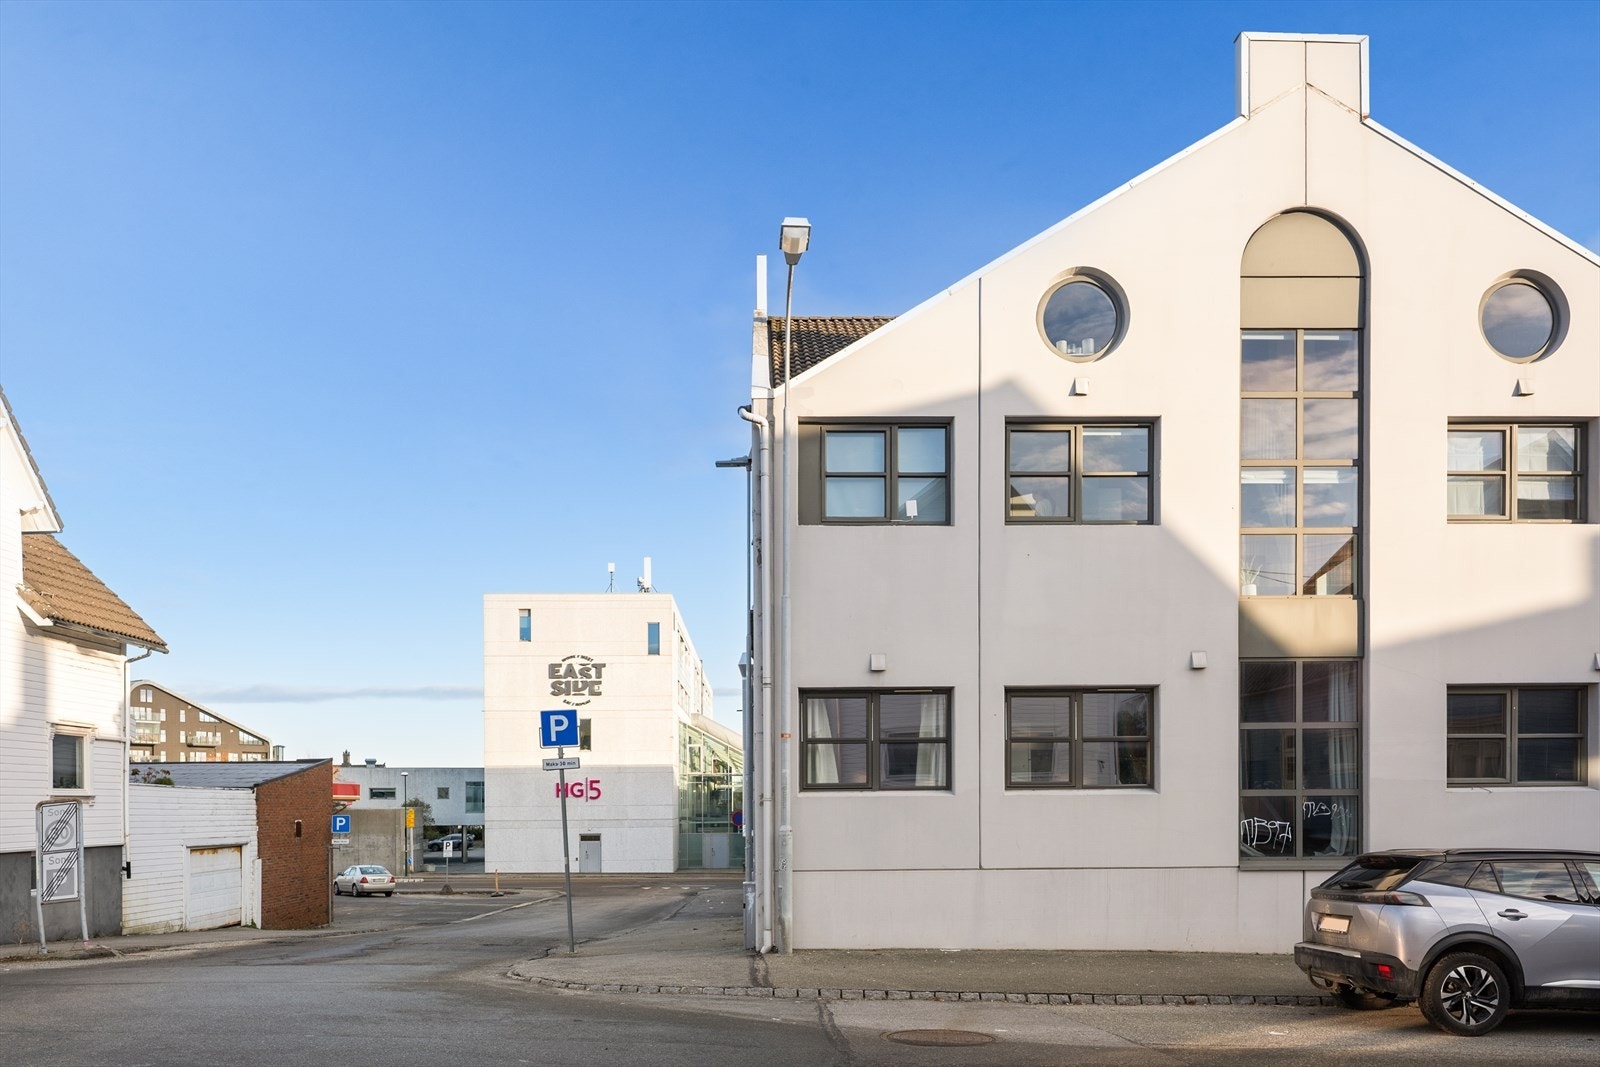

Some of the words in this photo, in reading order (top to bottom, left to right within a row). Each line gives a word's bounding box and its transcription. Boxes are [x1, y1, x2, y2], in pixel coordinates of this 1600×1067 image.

[548, 663, 606, 680] EAST
[550, 680, 602, 696] SIDE
[549, 714, 569, 742] P
[336, 817, 346, 830] P
[445, 841, 451, 850] P
